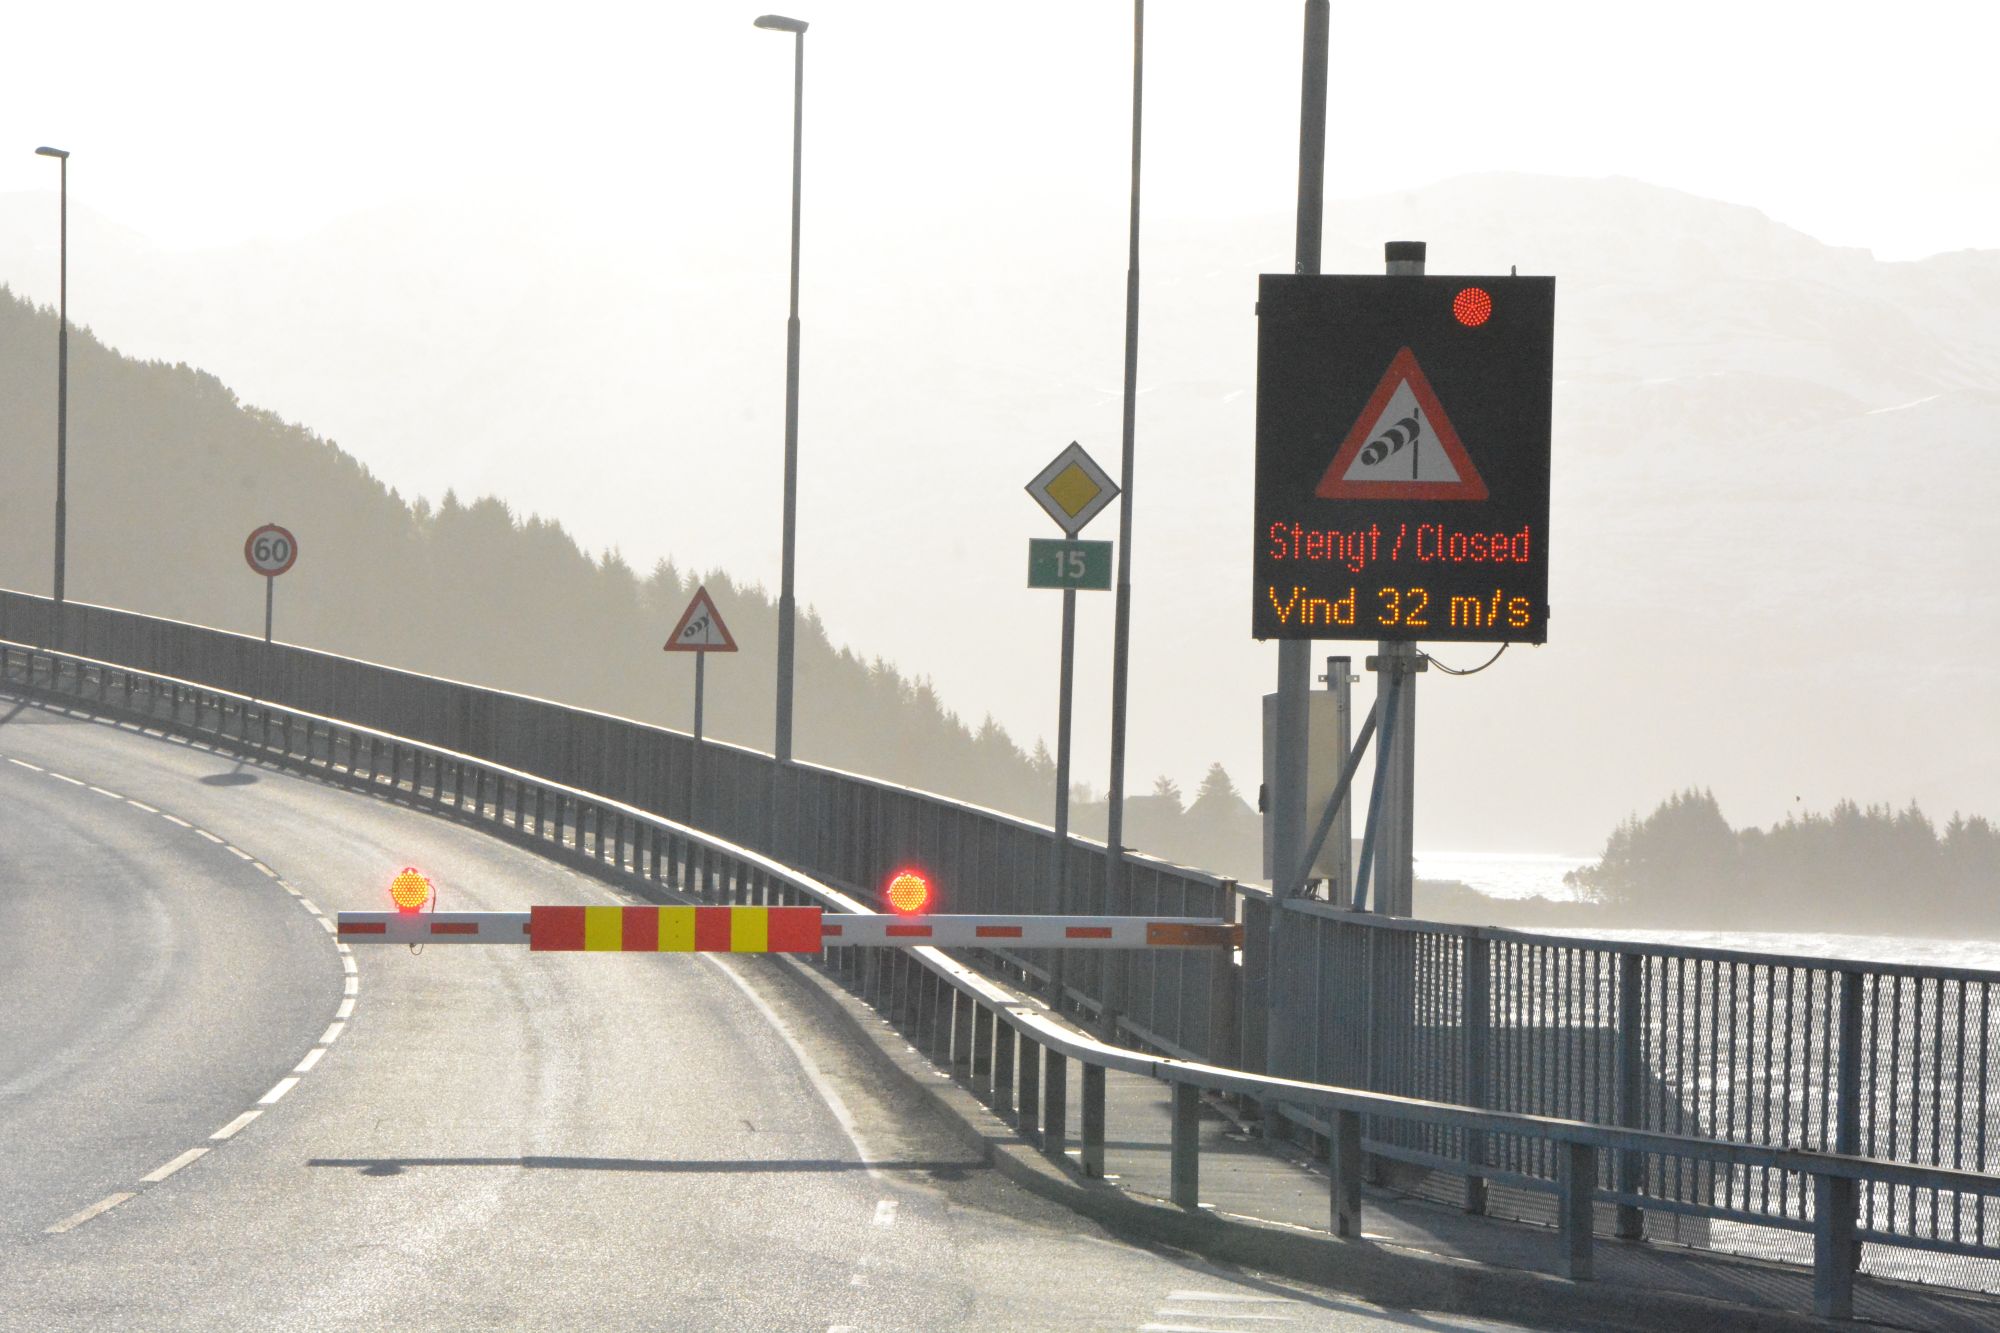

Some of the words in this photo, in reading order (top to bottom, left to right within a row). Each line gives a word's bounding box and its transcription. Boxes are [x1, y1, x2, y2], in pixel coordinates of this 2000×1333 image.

[254, 538, 288, 562] 60
[1055, 550, 1086, 578] 15
[1270, 522, 1381, 572] Stengt
[1392, 523, 1406, 560] /
[1417, 523, 1529, 562] Closed
[1270, 586, 1355, 624] Vind
[1378, 587, 1429, 626] 32
[1451, 589, 1530, 627] m/s
